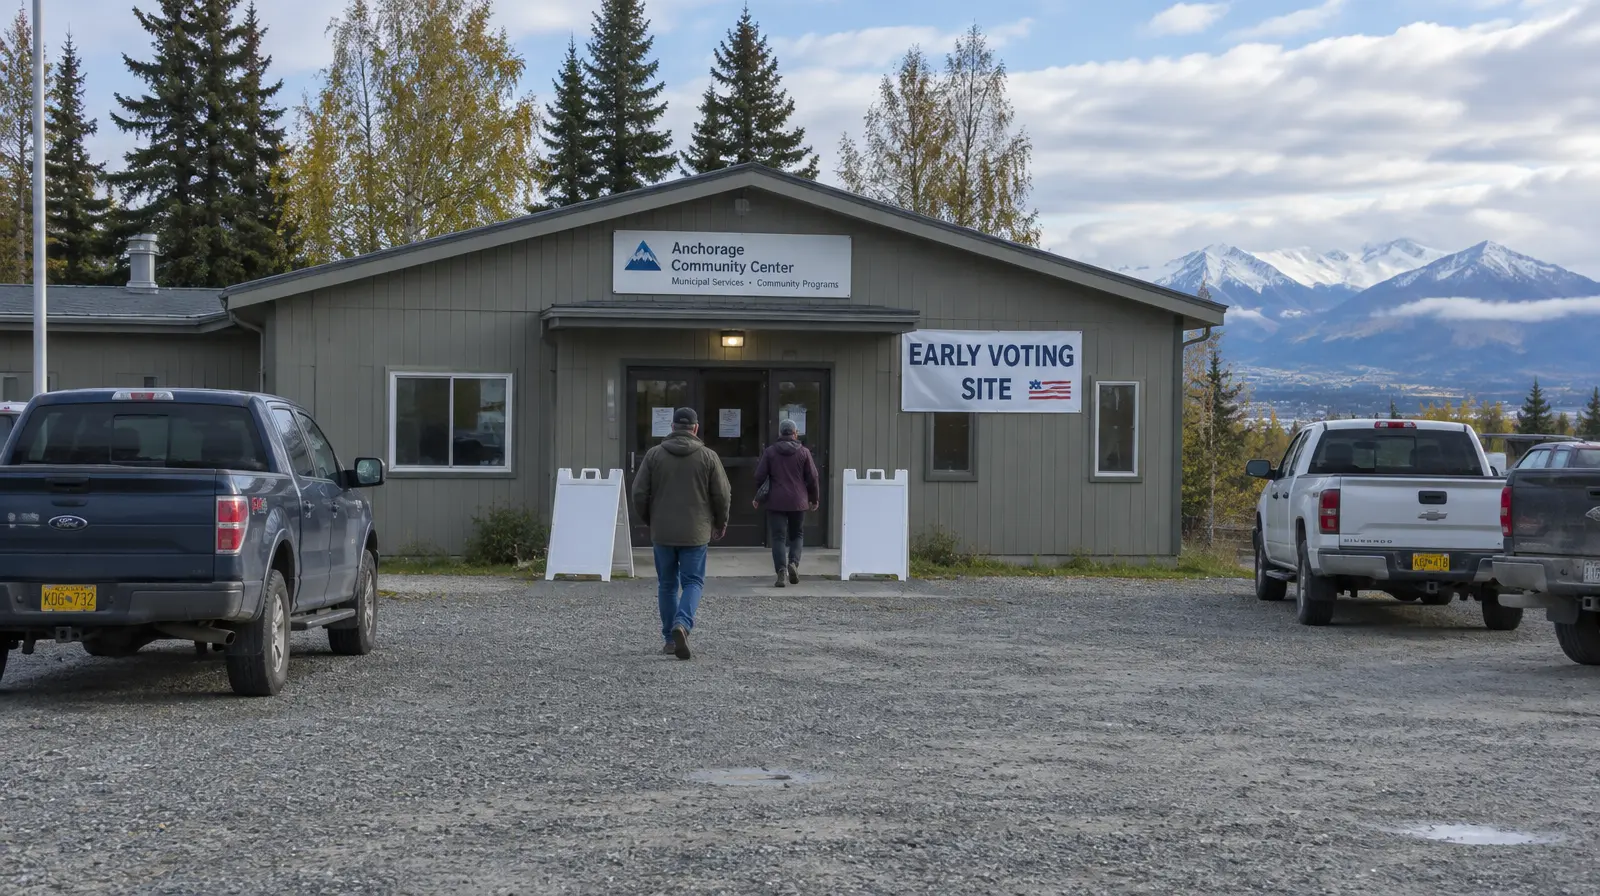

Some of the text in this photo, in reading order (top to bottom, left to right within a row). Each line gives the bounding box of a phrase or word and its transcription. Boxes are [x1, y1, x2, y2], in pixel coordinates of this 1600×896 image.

[672, 241, 745, 258] Anchorage
[671, 259, 794, 275] Community Center
[671, 277, 839, 290] Municipal Services Community Programs
[909, 343, 1074, 367] EARLY VOTING
[961, 377, 1012, 400] SITE
[73, 592, 94, 606] 732
